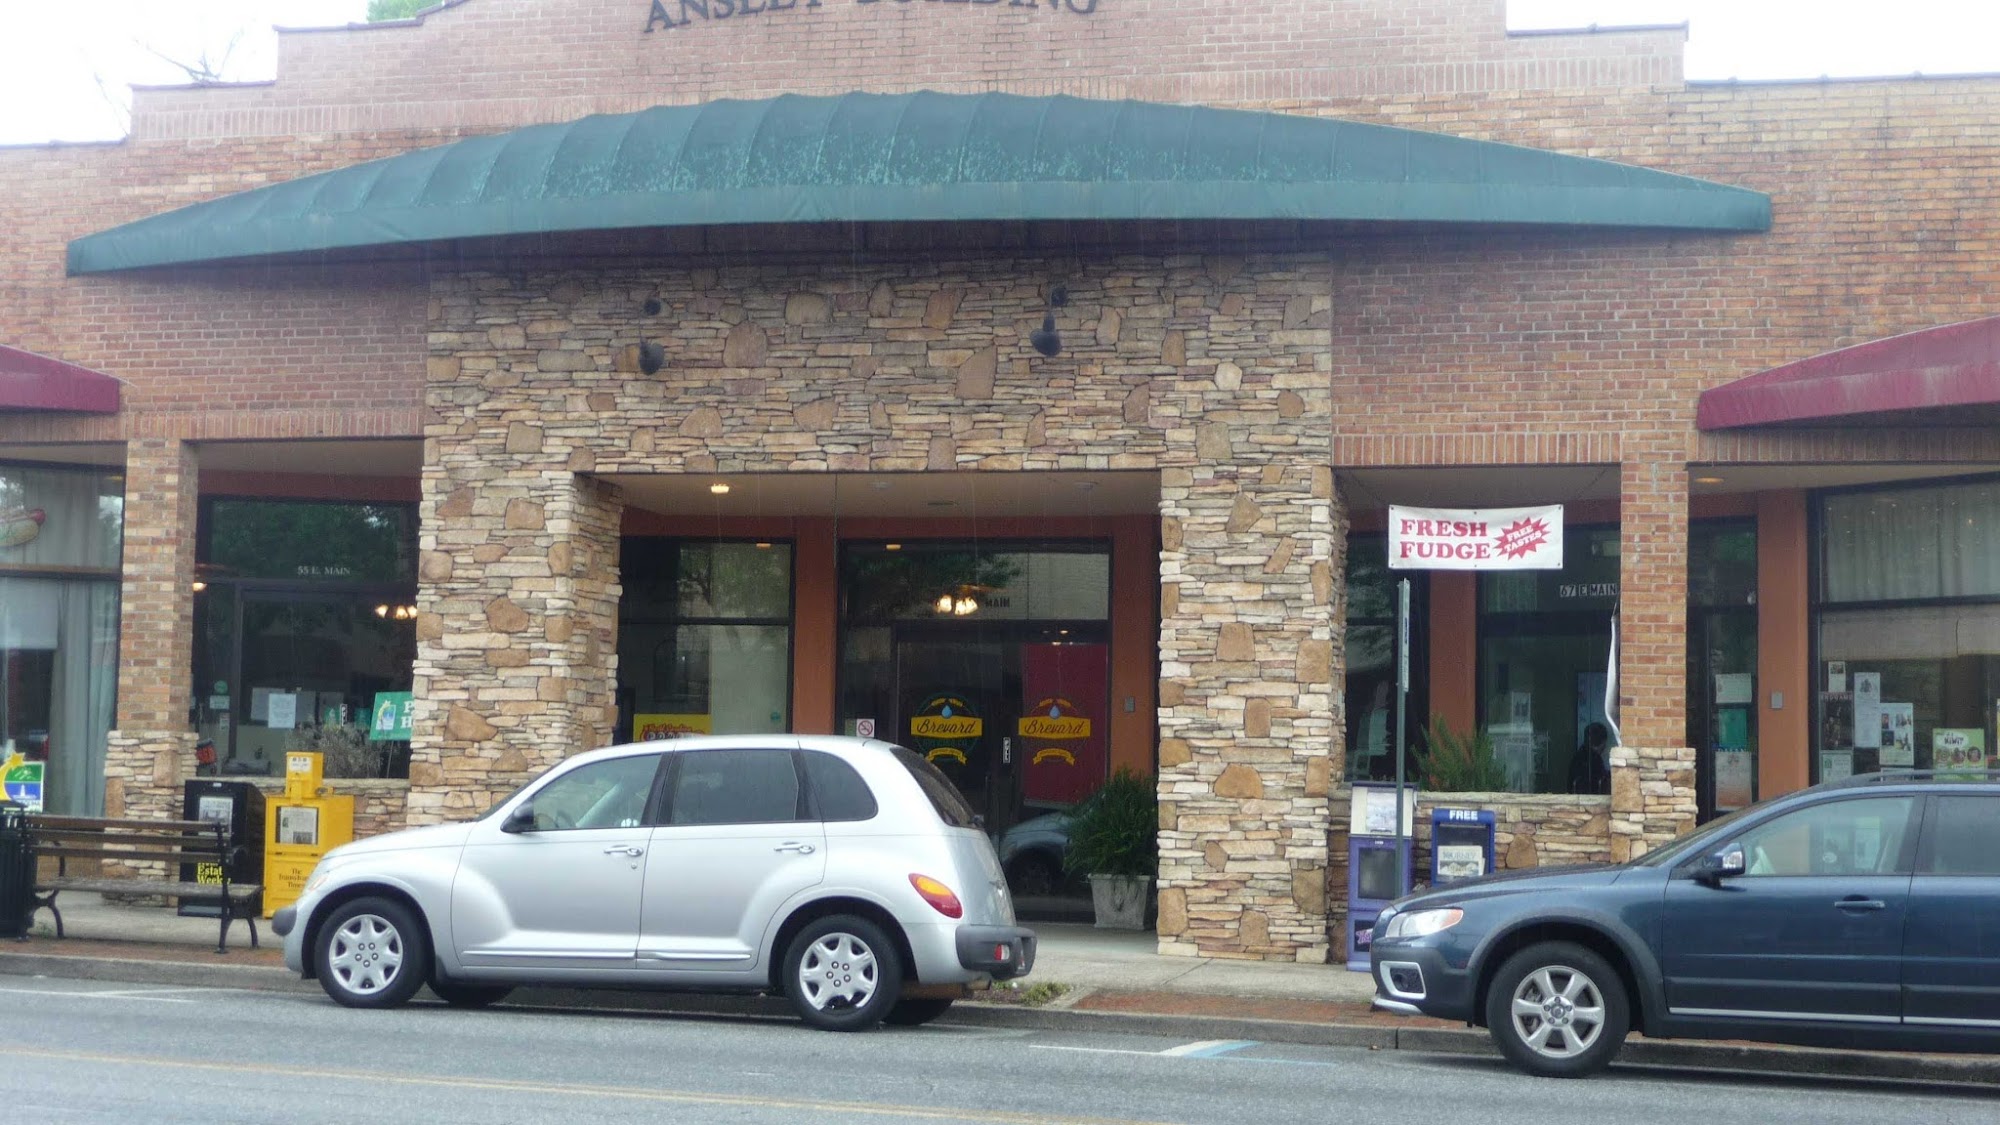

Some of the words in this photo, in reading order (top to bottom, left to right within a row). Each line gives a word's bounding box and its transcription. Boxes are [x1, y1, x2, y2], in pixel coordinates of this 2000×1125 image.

[1400, 518, 1489, 537] FRESH
[1506, 525, 1533, 542] FREE
[1504, 530, 1543, 552] TASTES
[1400, 541, 1491, 560] FUDGE
[297, 565, 309, 576] 55
[324, 565, 351, 576] MAIN
[1560, 585, 1576, 597] 67
[1590, 583, 1617, 596] MAIN
[985, 597, 1010, 608] MAIN
[917, 719, 976, 734] Brevard
[1024, 719, 1085, 734] Brevard
[1449, 809, 1479, 821] FREE
[197, 865, 224, 876] Estat
[197, 875, 232, 886] Weeky
